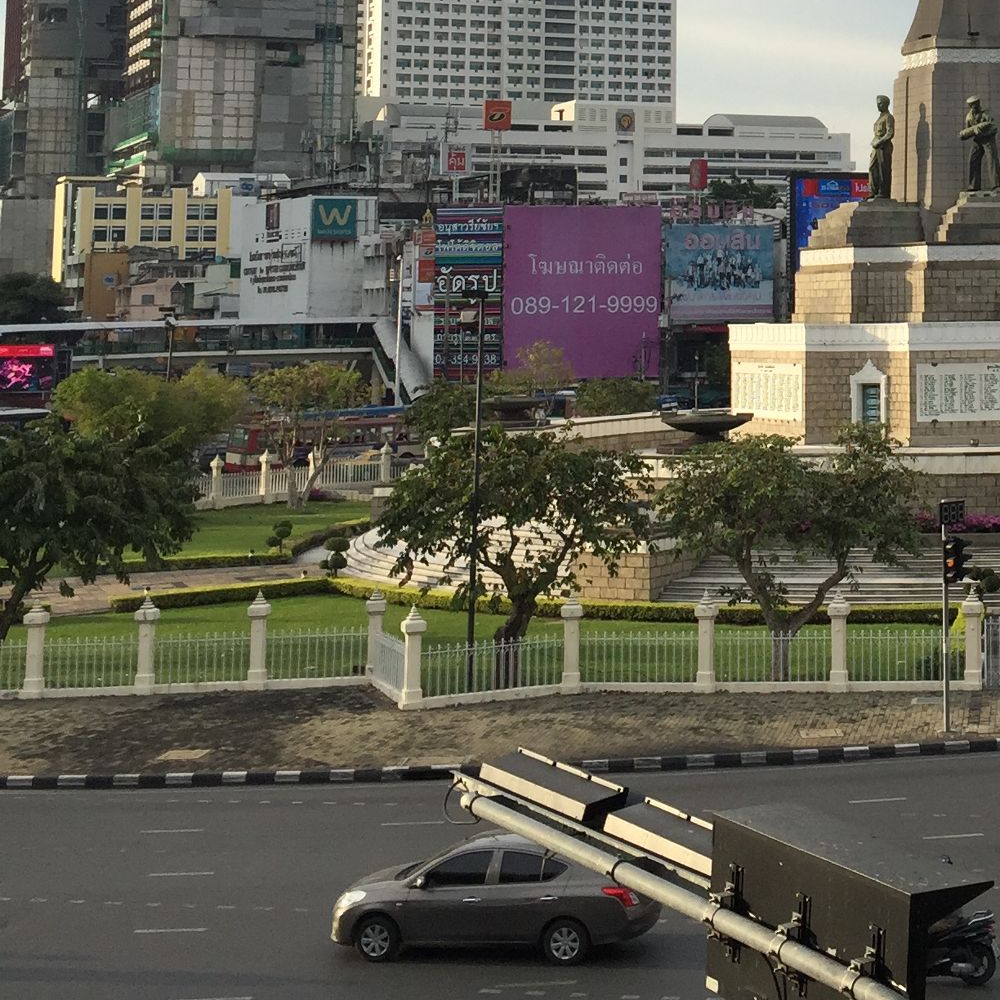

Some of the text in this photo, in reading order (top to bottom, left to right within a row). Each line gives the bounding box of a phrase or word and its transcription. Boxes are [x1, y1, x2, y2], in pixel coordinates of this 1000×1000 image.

[528, 253, 643, 275] โฆษณาติดต่อ
[511, 295, 658, 315] 089-121-9999
